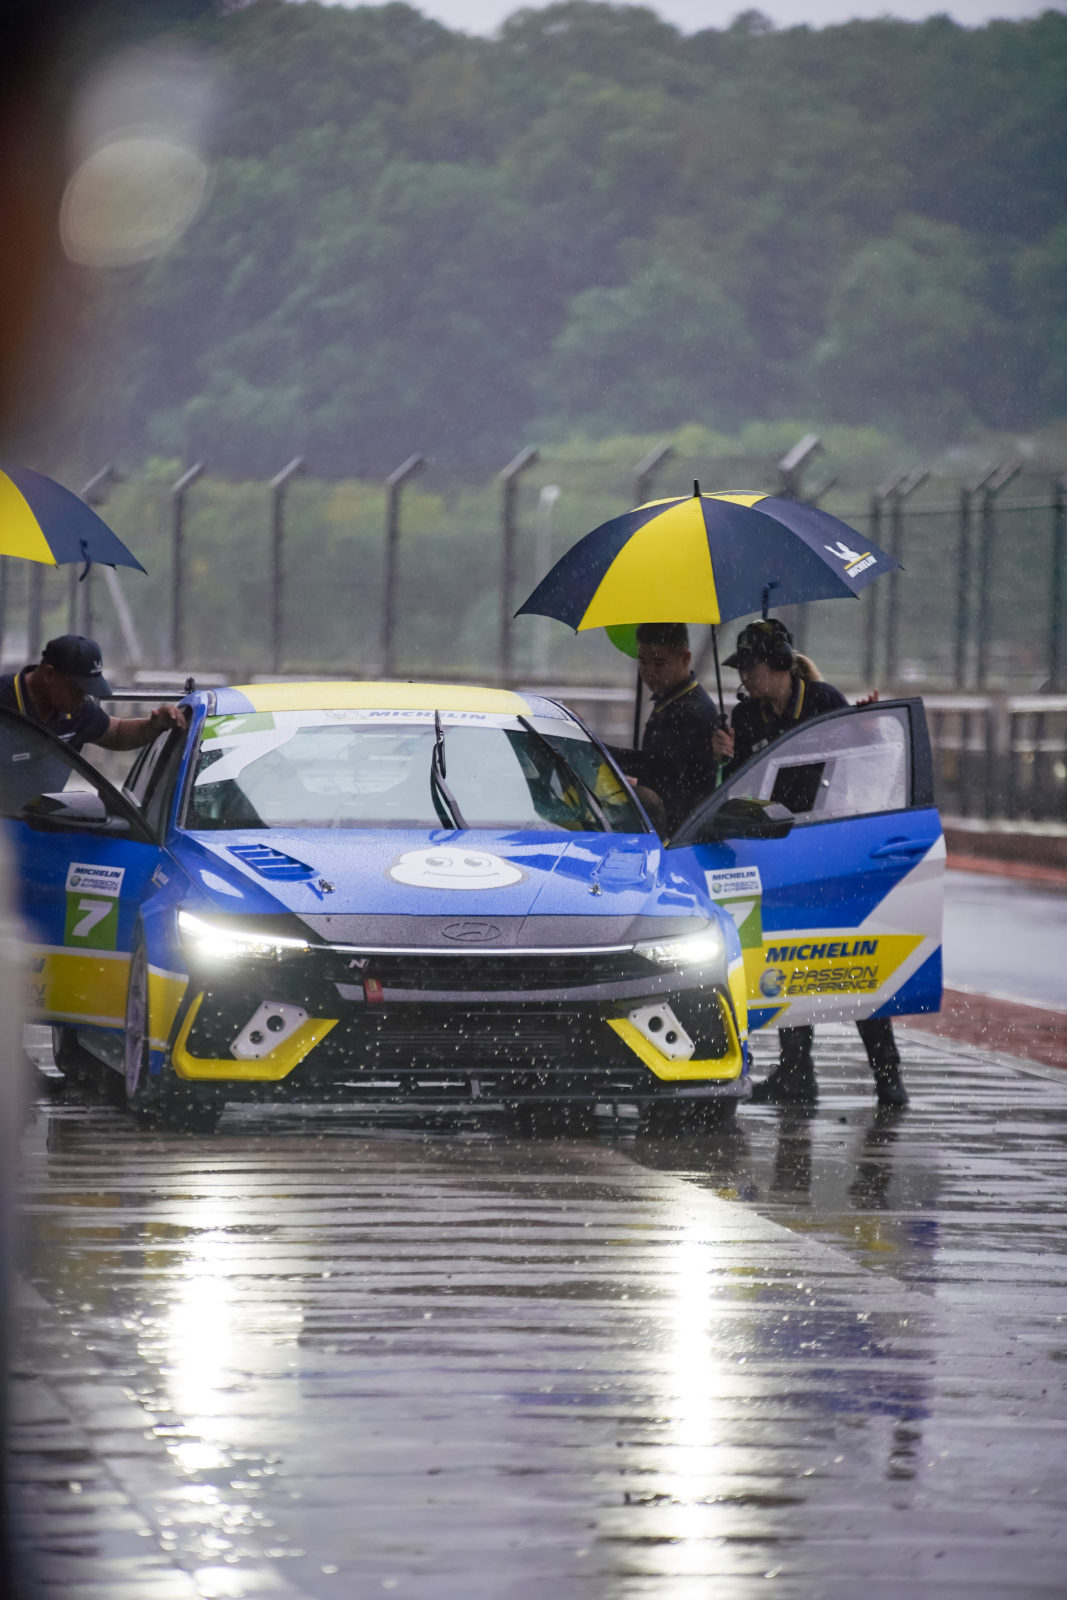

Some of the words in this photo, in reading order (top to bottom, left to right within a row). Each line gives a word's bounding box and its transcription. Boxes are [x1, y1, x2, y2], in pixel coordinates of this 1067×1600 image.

[74, 868, 122, 878] MICHELIN
[712, 871, 756, 880] MICHELIN
[72, 899, 113, 937] 7
[765, 940, 878, 963] MICHELIN
[790, 966, 878, 984] PASSION
[787, 979, 878, 995] EXPERIENCE
